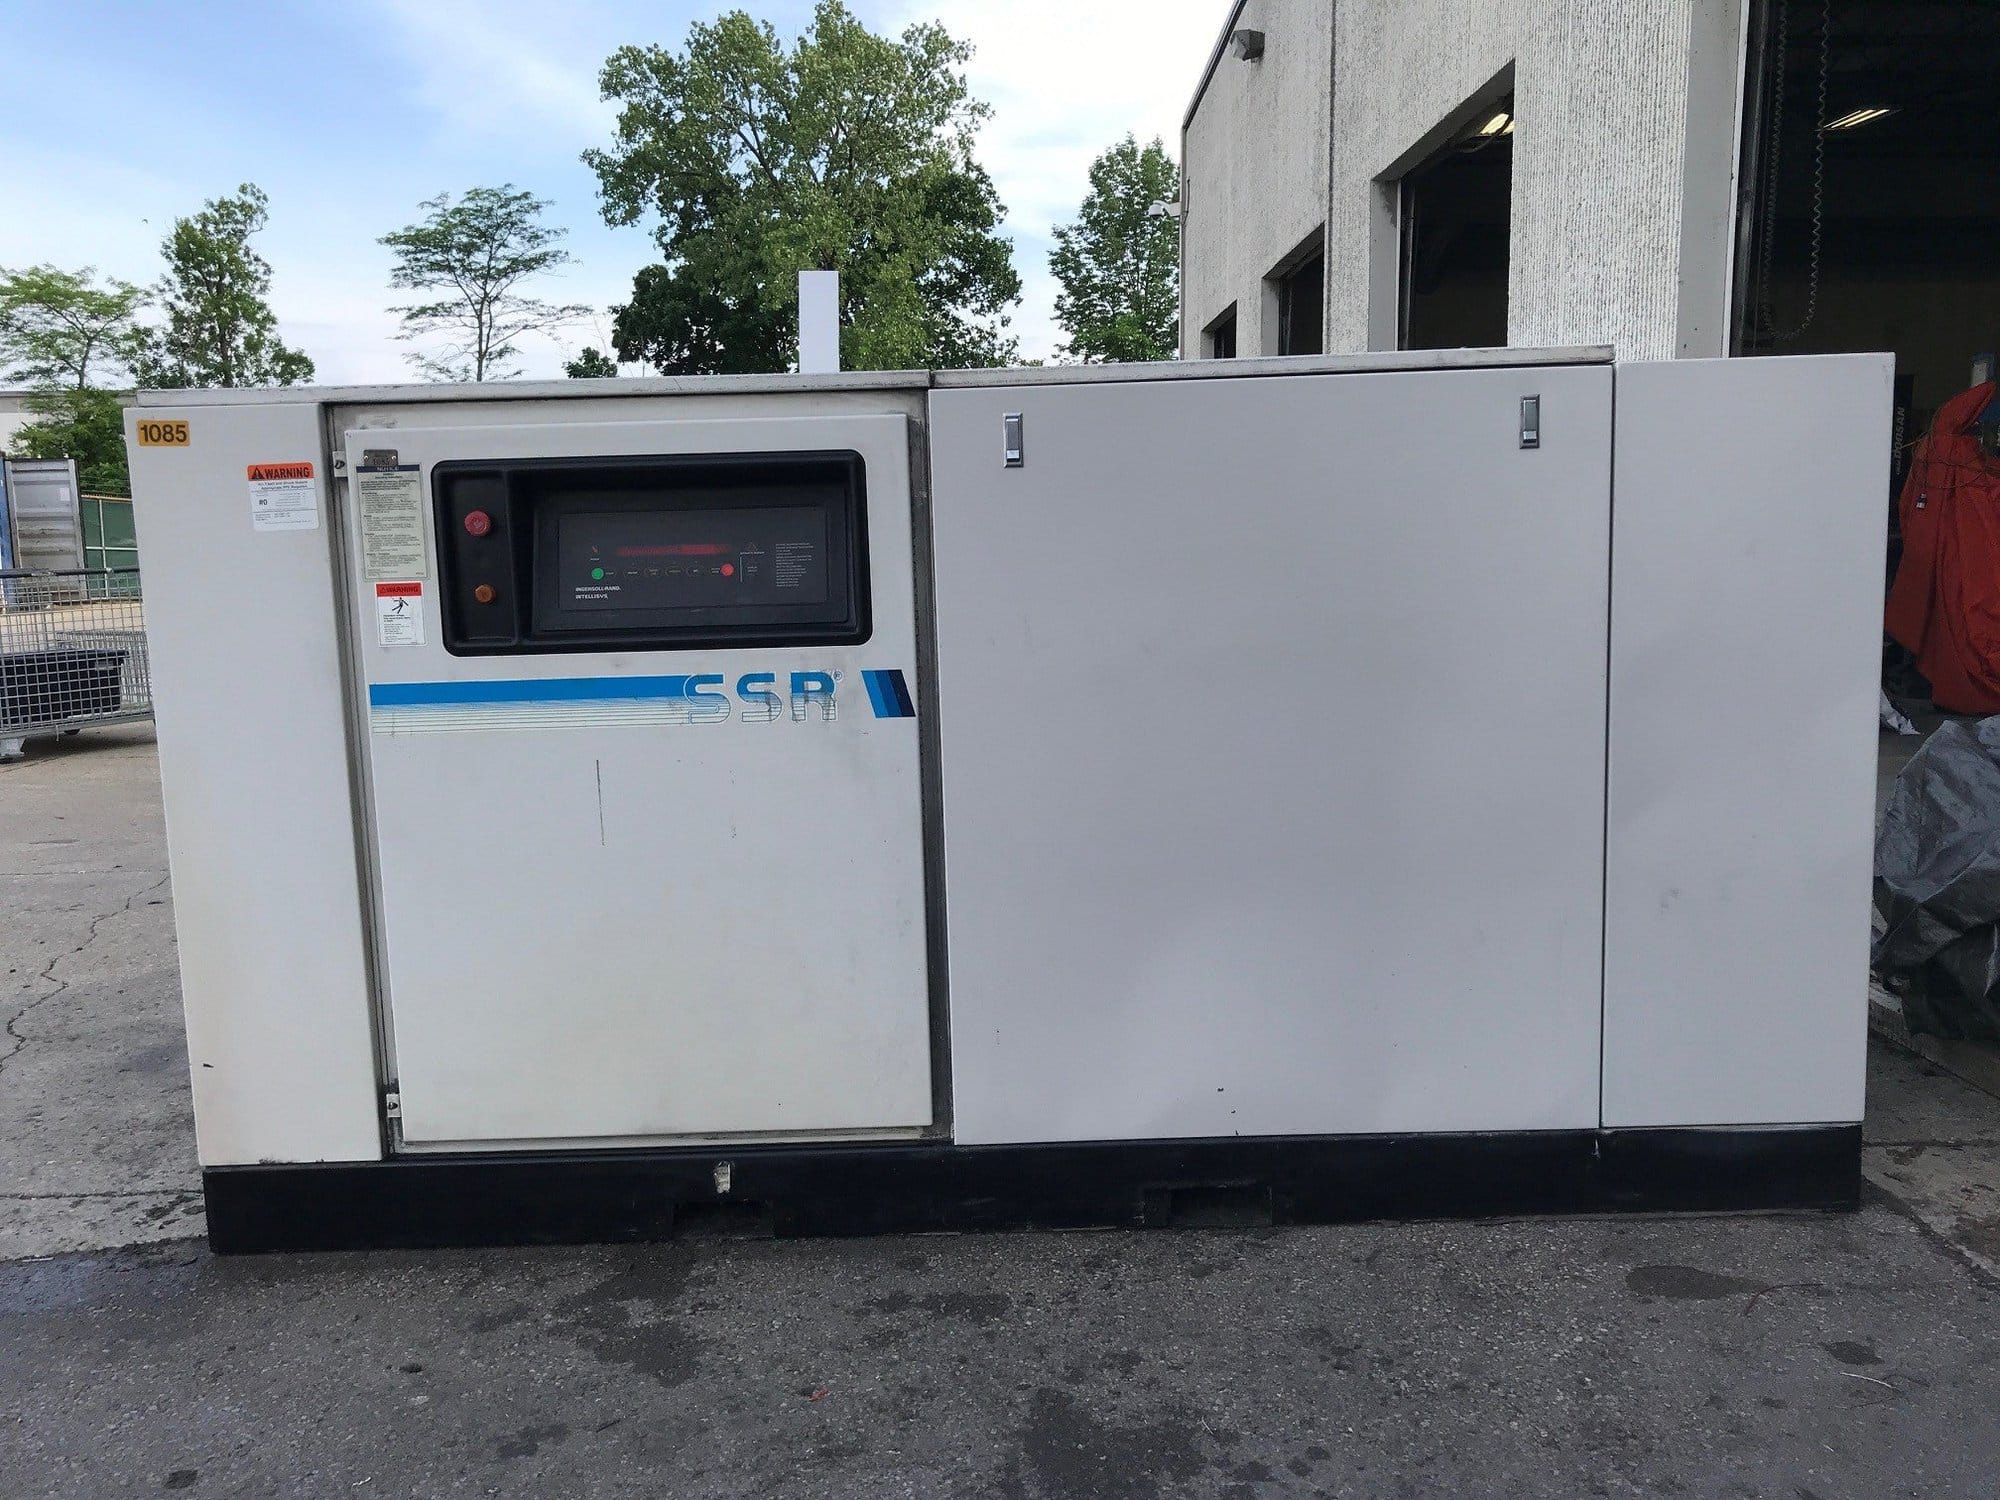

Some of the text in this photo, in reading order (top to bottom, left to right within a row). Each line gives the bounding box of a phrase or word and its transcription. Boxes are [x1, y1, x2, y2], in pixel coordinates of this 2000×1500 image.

[140, 424, 187, 443] 1085
[264, 467, 310, 480] WARNING
[683, 671, 837, 725] SSR
